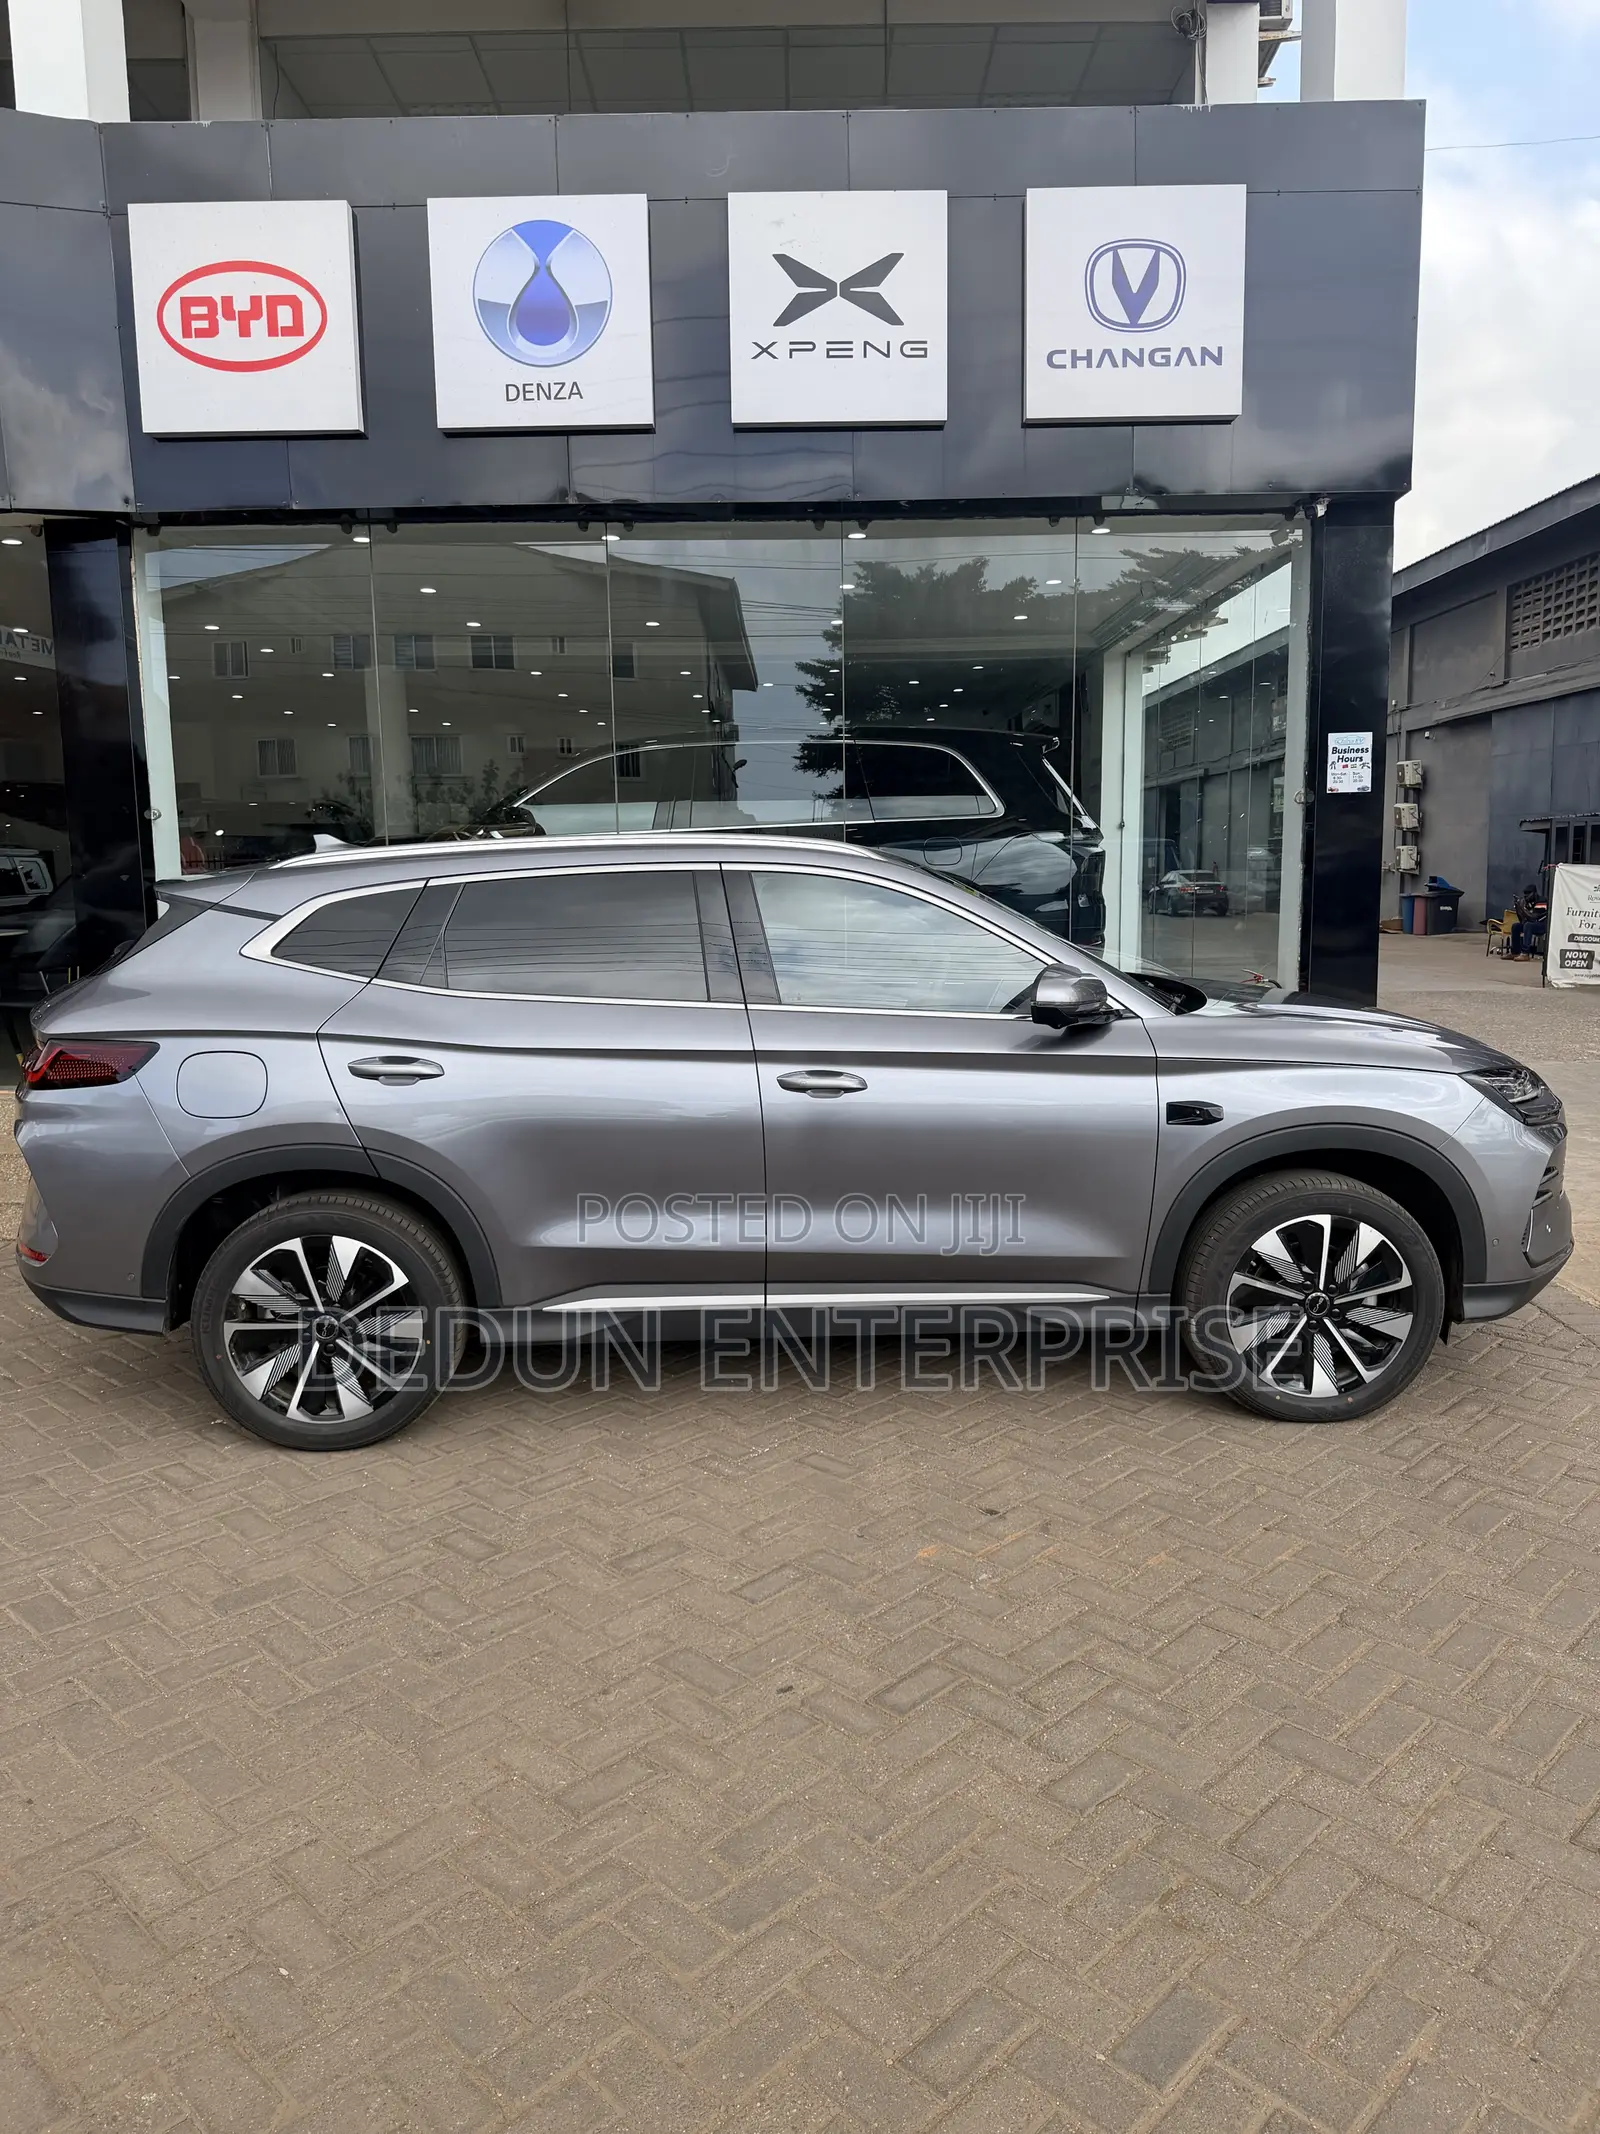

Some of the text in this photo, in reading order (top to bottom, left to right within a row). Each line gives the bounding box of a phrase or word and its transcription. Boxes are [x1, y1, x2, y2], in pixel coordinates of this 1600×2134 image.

[180, 294, 305, 338] BYD
[751, 340, 928, 360] XPENG
[1046, 346, 1223, 369] CHANGAN
[505, 381, 584, 402] DENZA
[1331, 746, 1370, 755] Business
[1337, 755, 1364, 763] Hours
[1566, 907, 1600, 918] Furnit
[1579, 919, 1597, 929] For
[1565, 951, 1589, 959] NOW
[1564, 960, 1588, 968] OPEN
